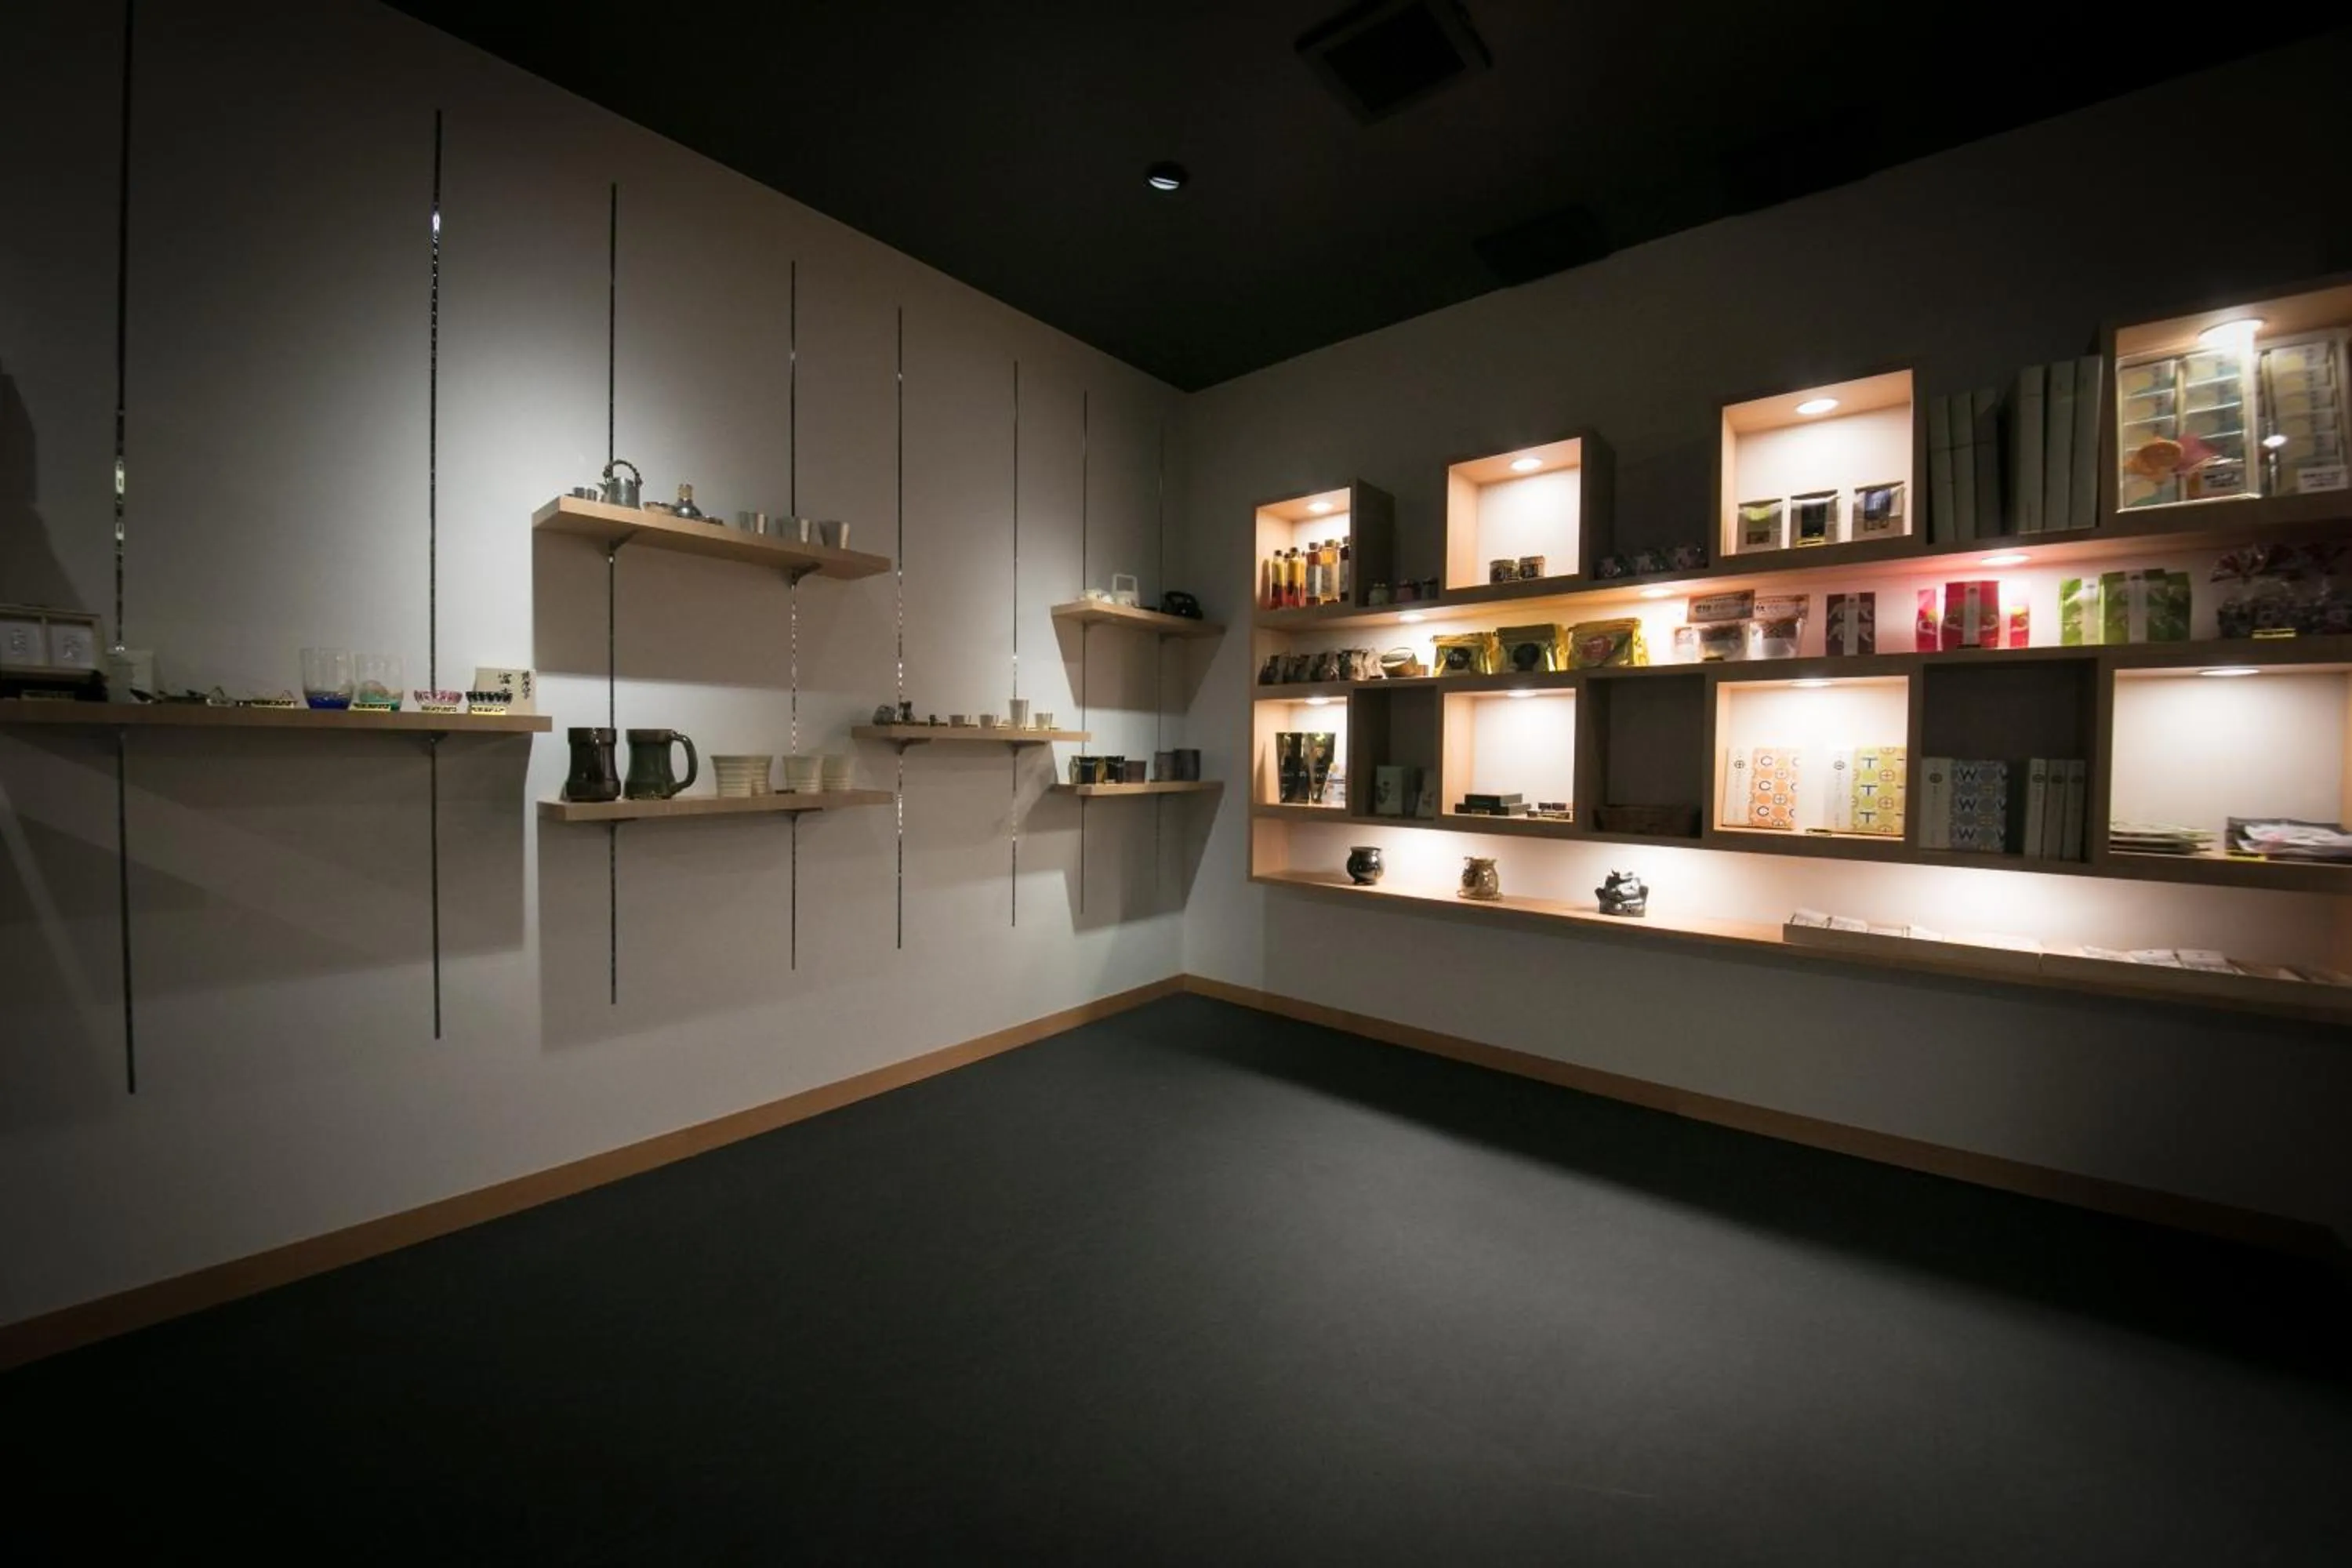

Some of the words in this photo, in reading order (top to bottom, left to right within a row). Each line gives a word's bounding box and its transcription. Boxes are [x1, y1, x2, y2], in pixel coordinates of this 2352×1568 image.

[1760, 755, 1773, 767] C
[1861, 757, 1878, 768] T
[1960, 768, 1978, 782] W
[1759, 780, 1772, 792] C
[1860, 784, 1878, 797] T
[1959, 798, 1977, 811] W
[1756, 805, 1769, 818] C
[1859, 811, 1877, 824] T
[1959, 828, 1976, 840] W
